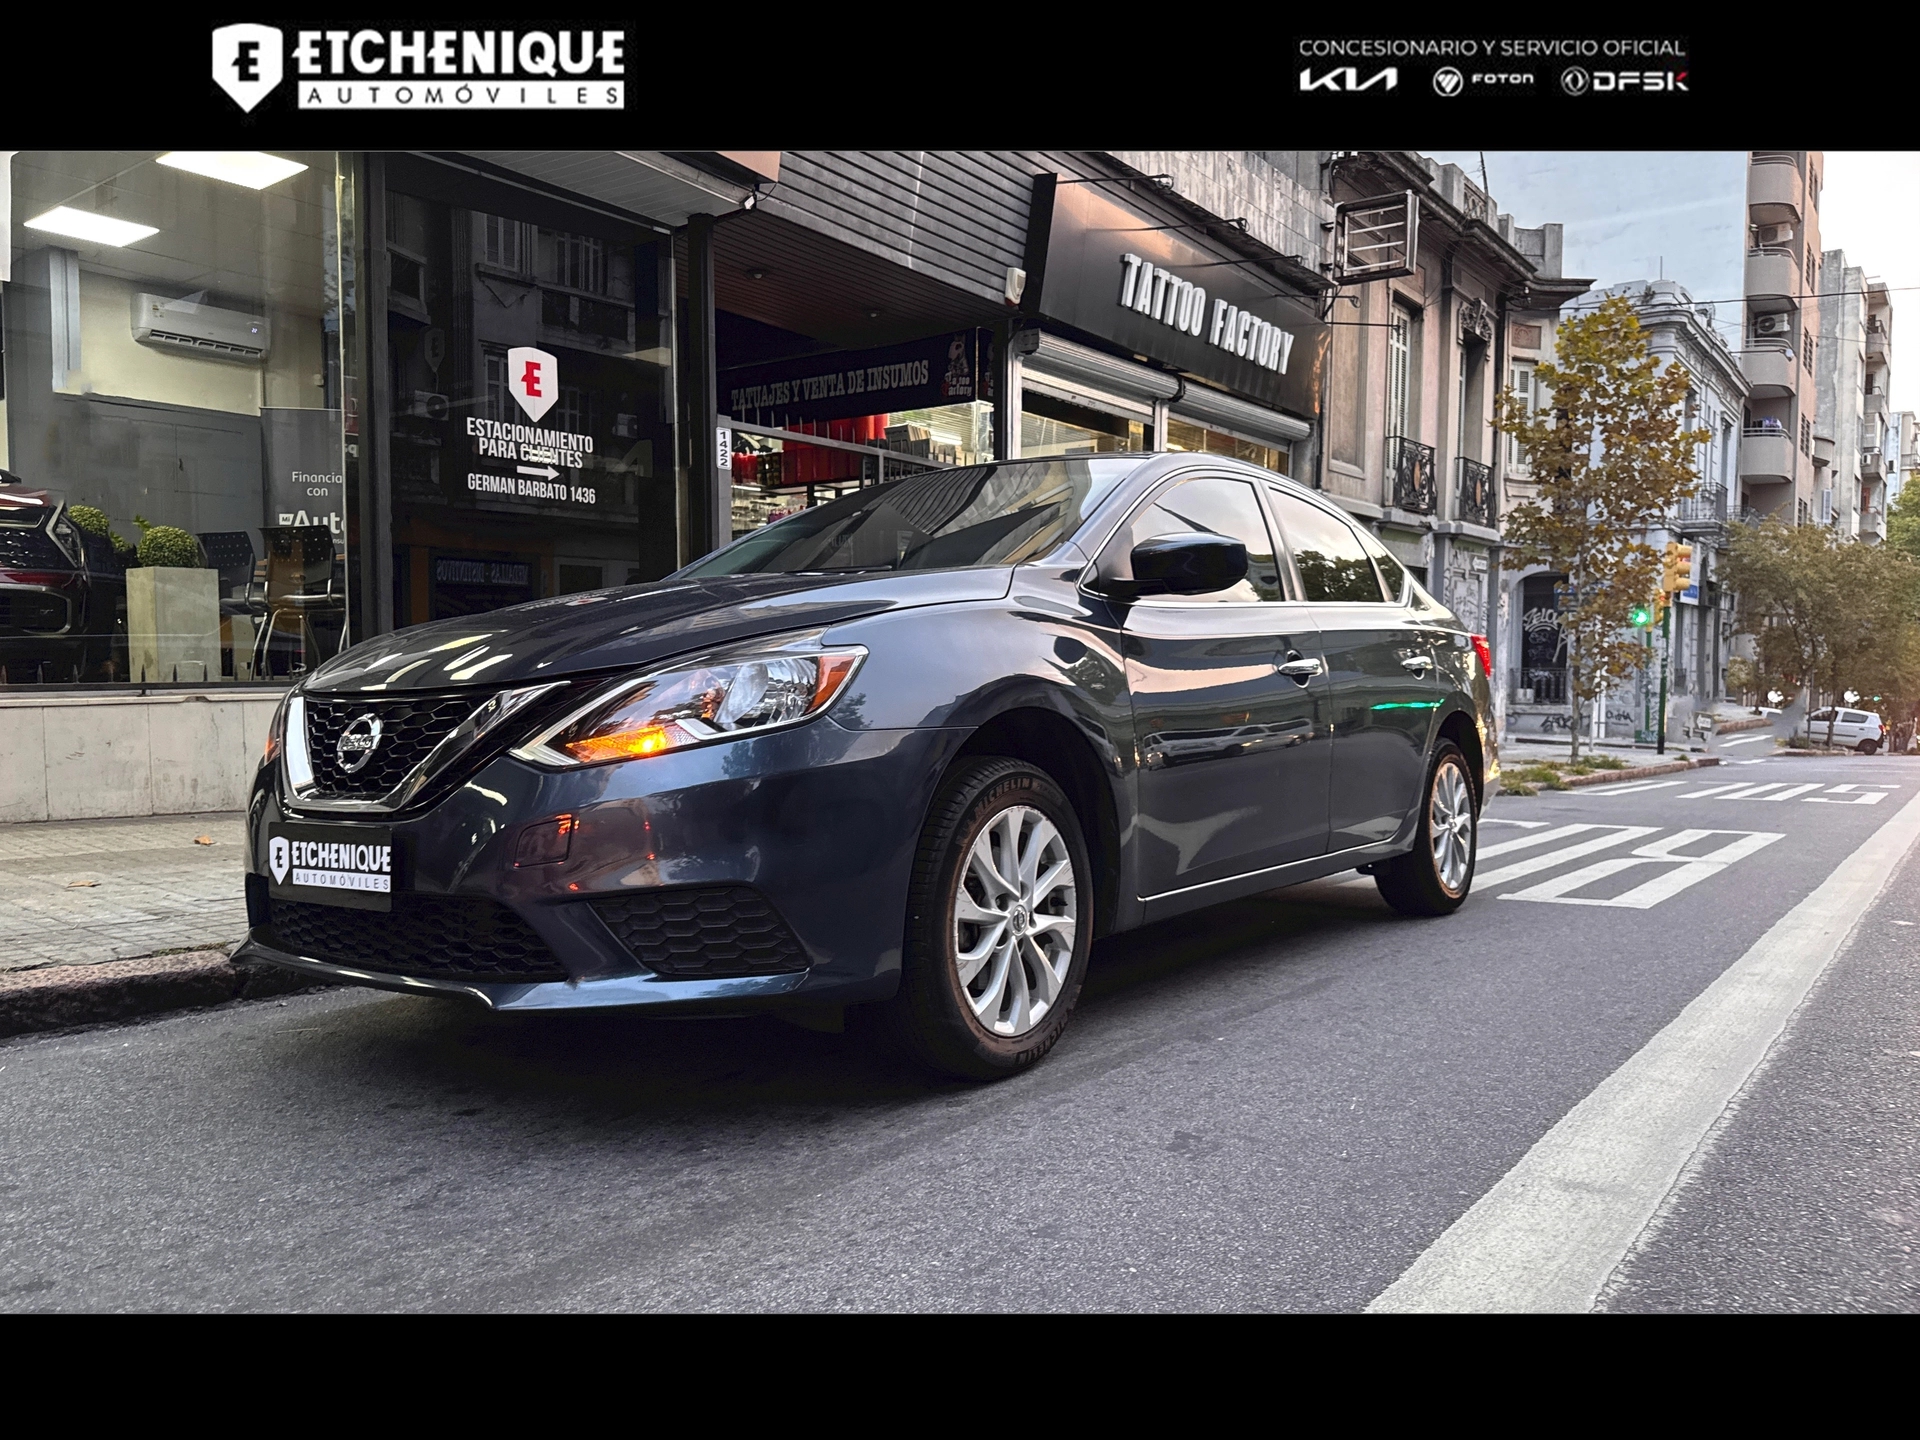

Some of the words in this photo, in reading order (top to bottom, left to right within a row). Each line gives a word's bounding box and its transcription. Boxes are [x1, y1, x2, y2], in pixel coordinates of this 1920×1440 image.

[1120, 253, 1206, 336] TATTOO
[1208, 298, 1295, 375] FACTORY
[731, 381, 791, 411] TATUAJES
[791, 380, 802, 401] Y
[802, 372, 845, 400] VENTA
[847, 368, 865, 395] DE
[866, 359, 929, 391] INSUMOS
[466, 416, 594, 454] ESTACIONAMIENTO
[719, 431, 728, 467] 1422
[478, 437, 517, 460] PARA
[519, 443, 584, 469] CLIENTES
[291, 471, 343, 484] Financia
[306, 487, 328, 496] con
[467, 473, 516, 495] GERMAN
[518, 479, 567, 501] BARBATO
[570, 486, 596, 505] 1436
[291, 841, 391, 872] ETCHENIQUE
[294, 871, 390, 890] AUTOMÓVILES
